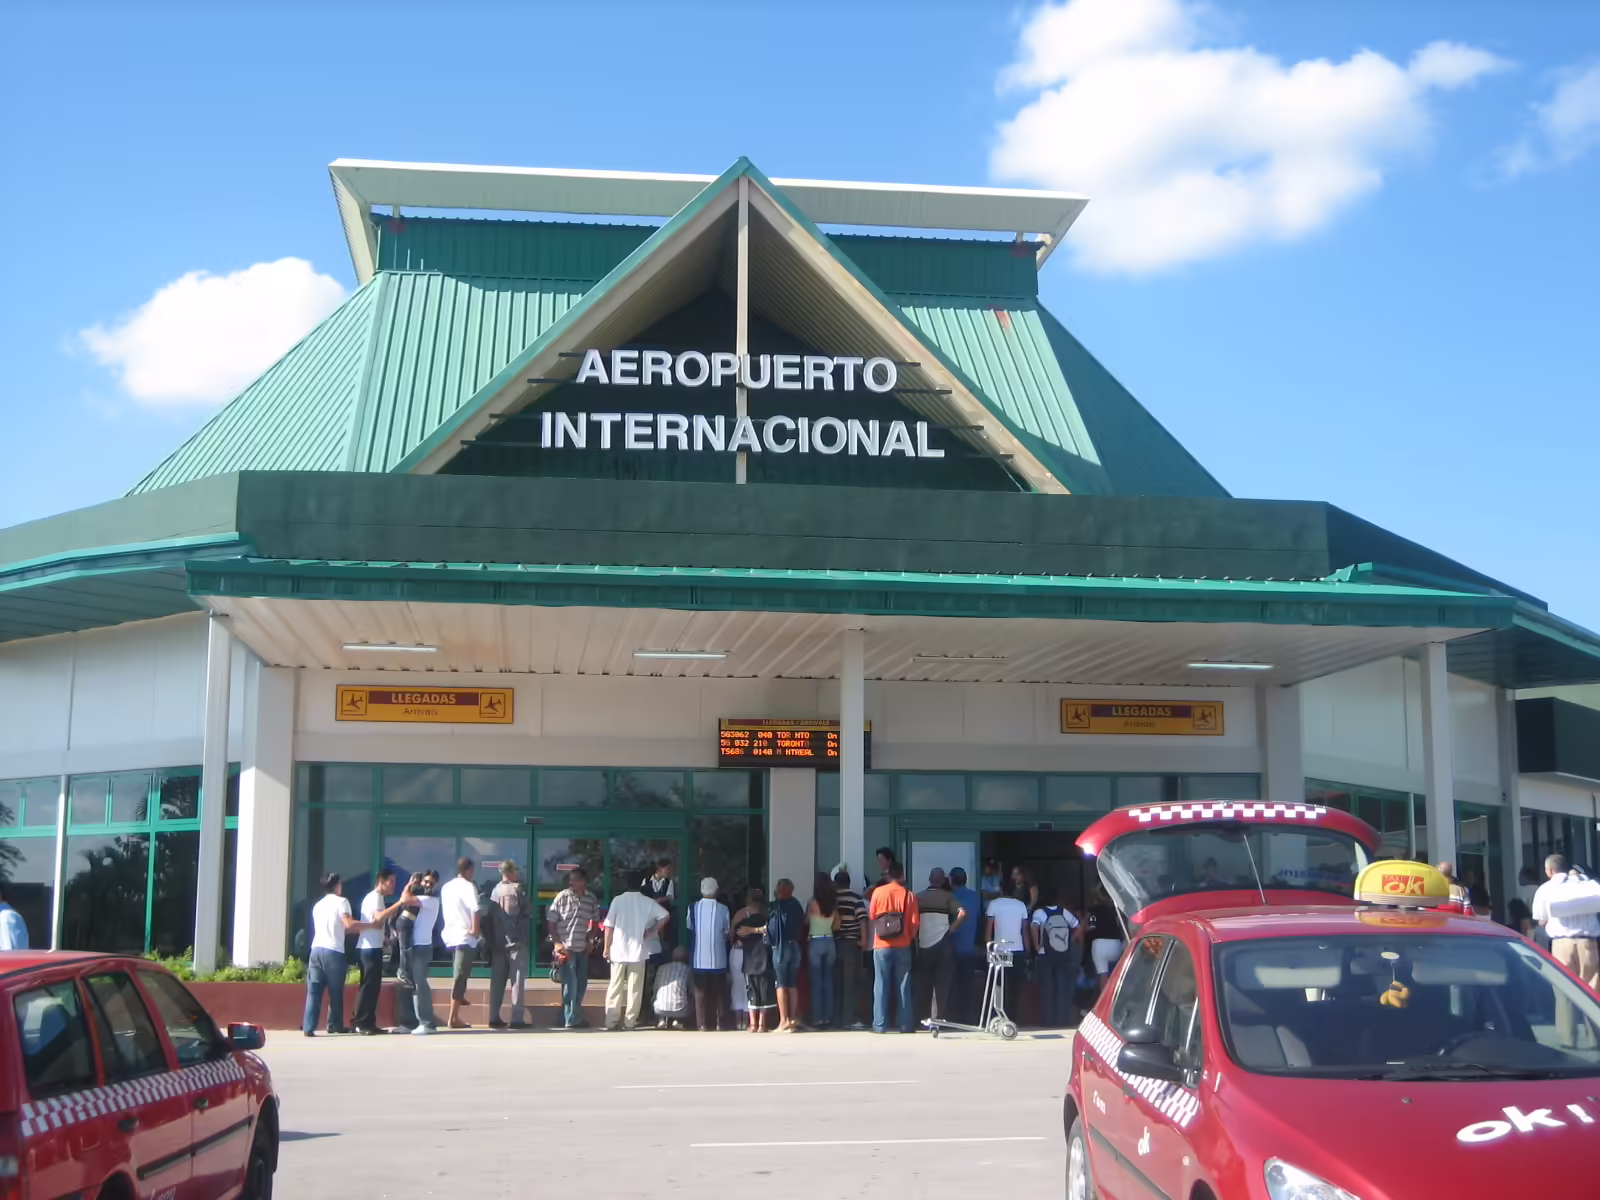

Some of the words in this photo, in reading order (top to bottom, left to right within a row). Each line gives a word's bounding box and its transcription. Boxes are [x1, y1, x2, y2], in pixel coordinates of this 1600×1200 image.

[576, 349, 898, 393] AEROPUERTO
[541, 411, 945, 458] INTERNACIONAL
[391, 693, 456, 704] LLEGADAS
[1112, 706, 1172, 717] LLEGADAS
